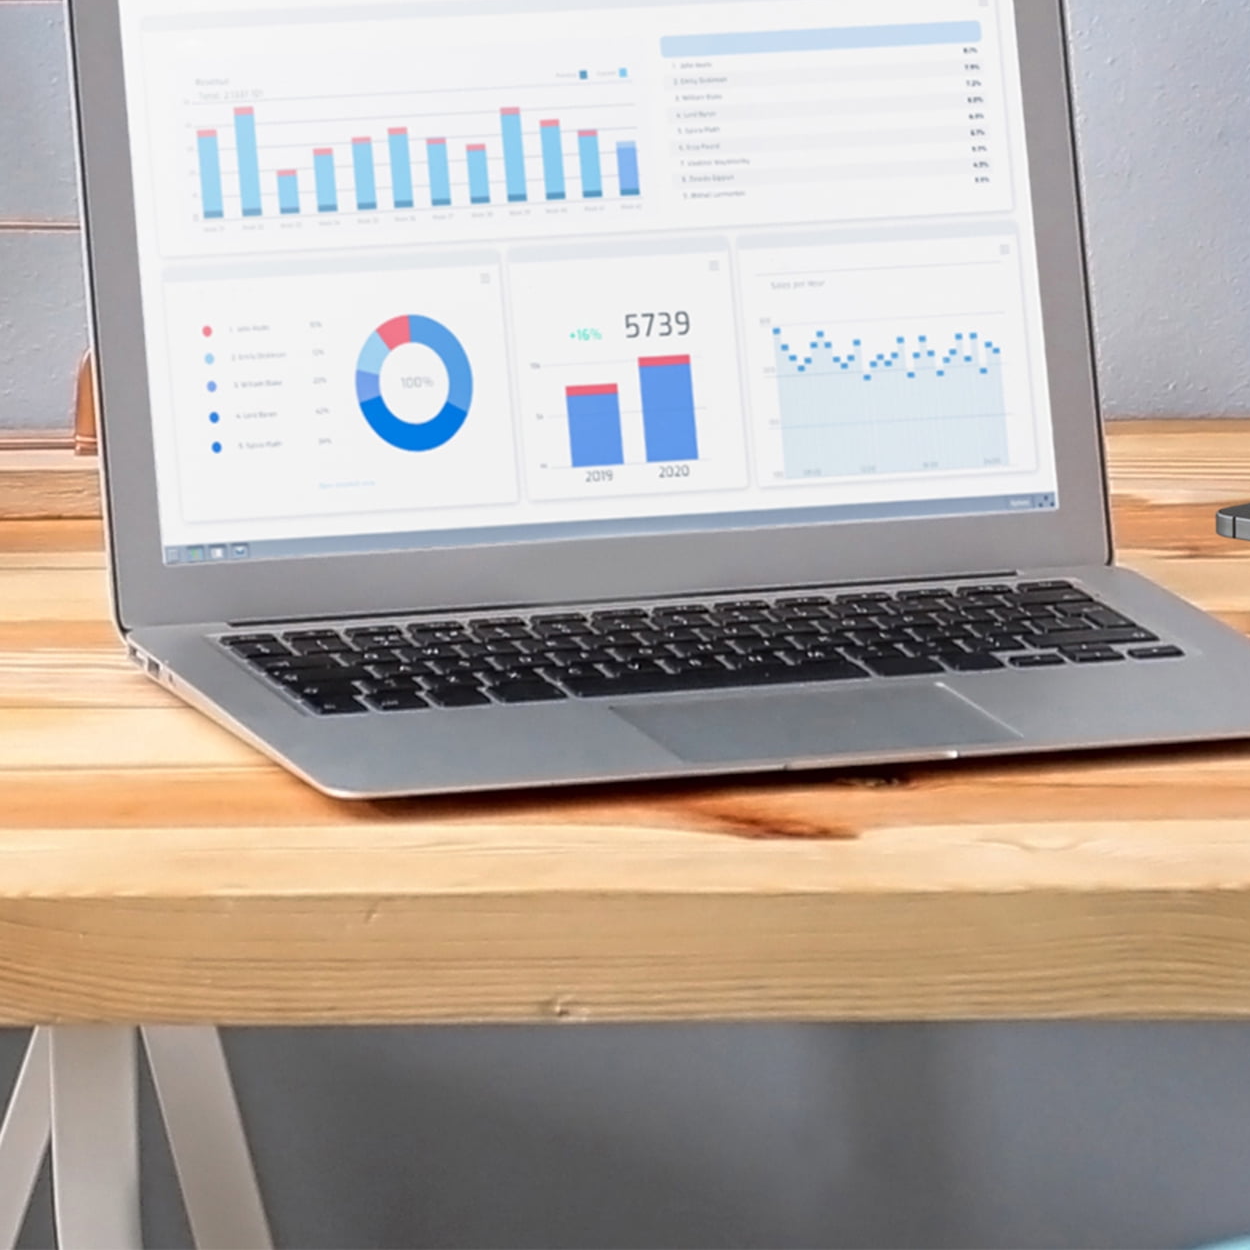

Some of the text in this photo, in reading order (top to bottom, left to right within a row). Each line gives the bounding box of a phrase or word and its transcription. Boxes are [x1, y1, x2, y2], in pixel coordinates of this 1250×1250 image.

[625, 311, 690, 338] 5739
[569, 328, 602, 341] +16%
[401, 376, 434, 389] 100%
[586, 470, 613, 482] 2019
[659, 465, 690, 478] 2020
